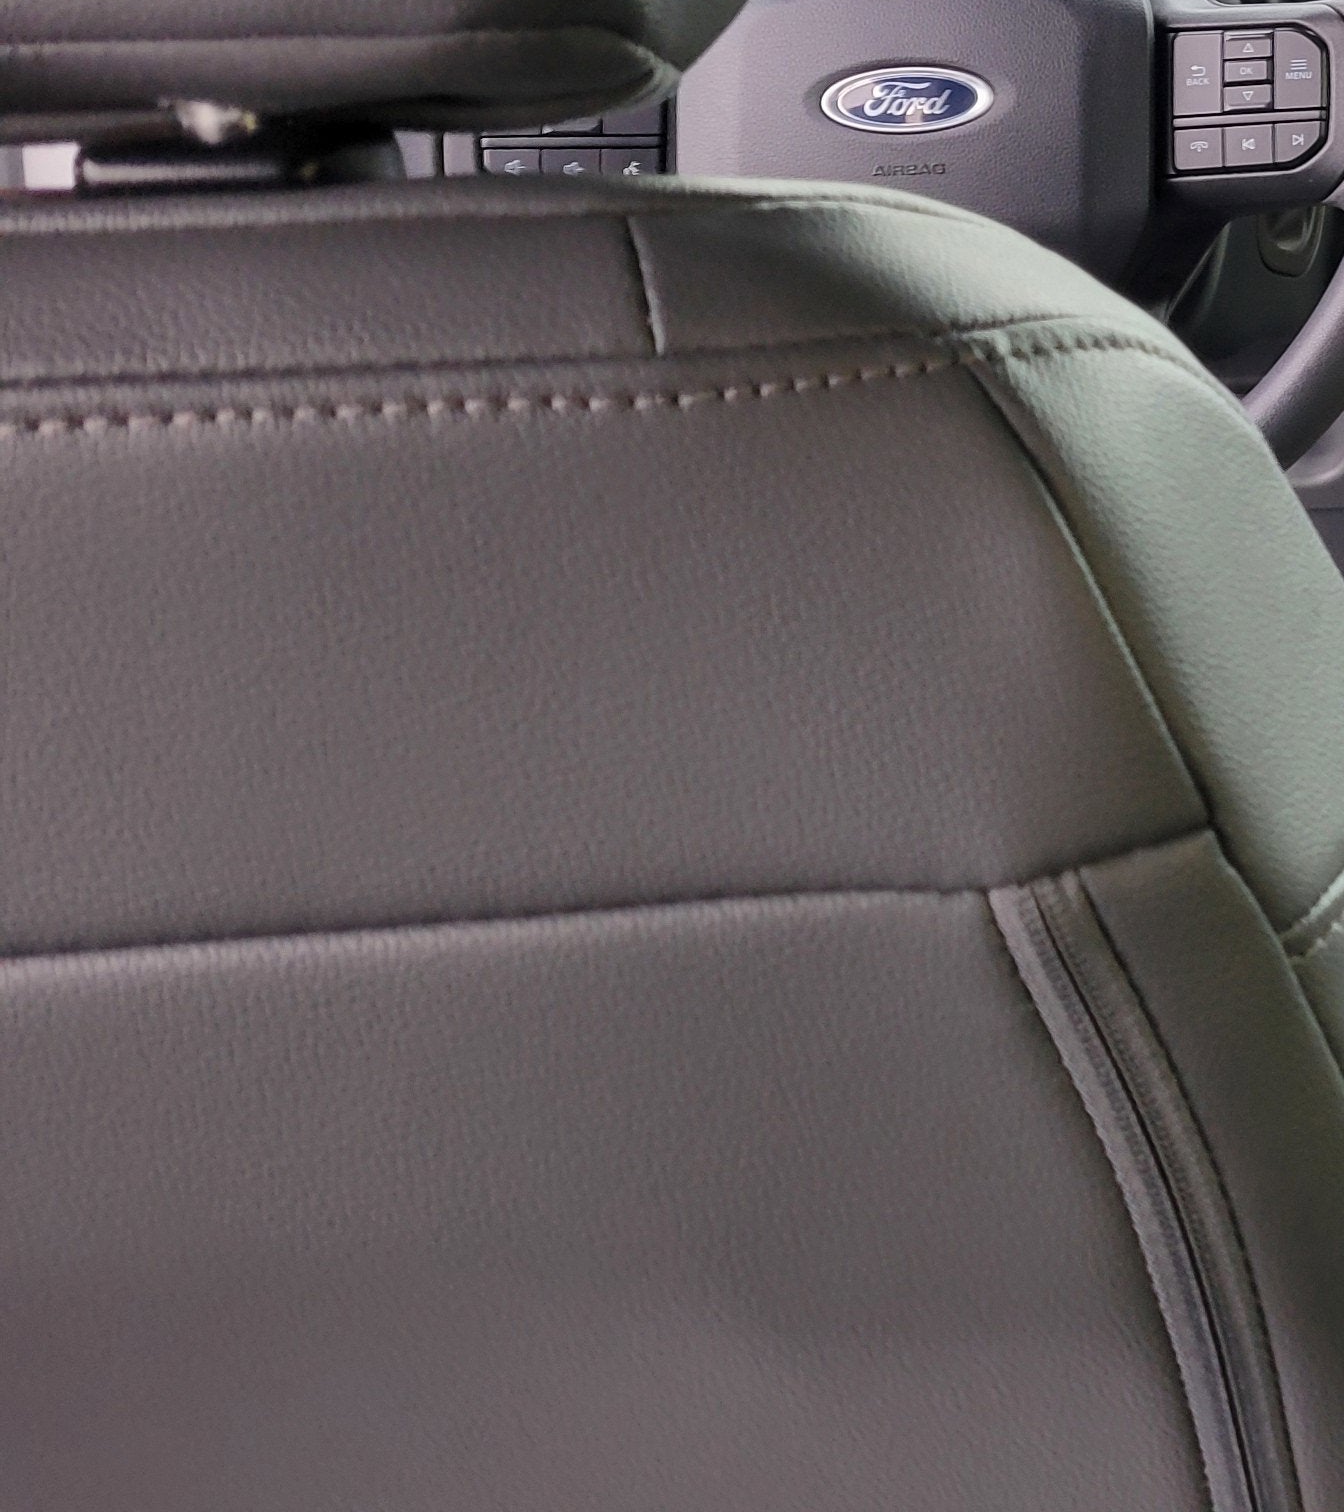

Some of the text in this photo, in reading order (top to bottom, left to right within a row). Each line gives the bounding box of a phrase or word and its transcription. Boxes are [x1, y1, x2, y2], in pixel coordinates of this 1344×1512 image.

[1239, 67, 1253, 75] OK
[1285, 71, 1313, 80] MENU
[1186, 78, 1210, 86] BACK
[863, 81, 952, 117] Ford
[871, 163, 946, 177] AIRBAG
